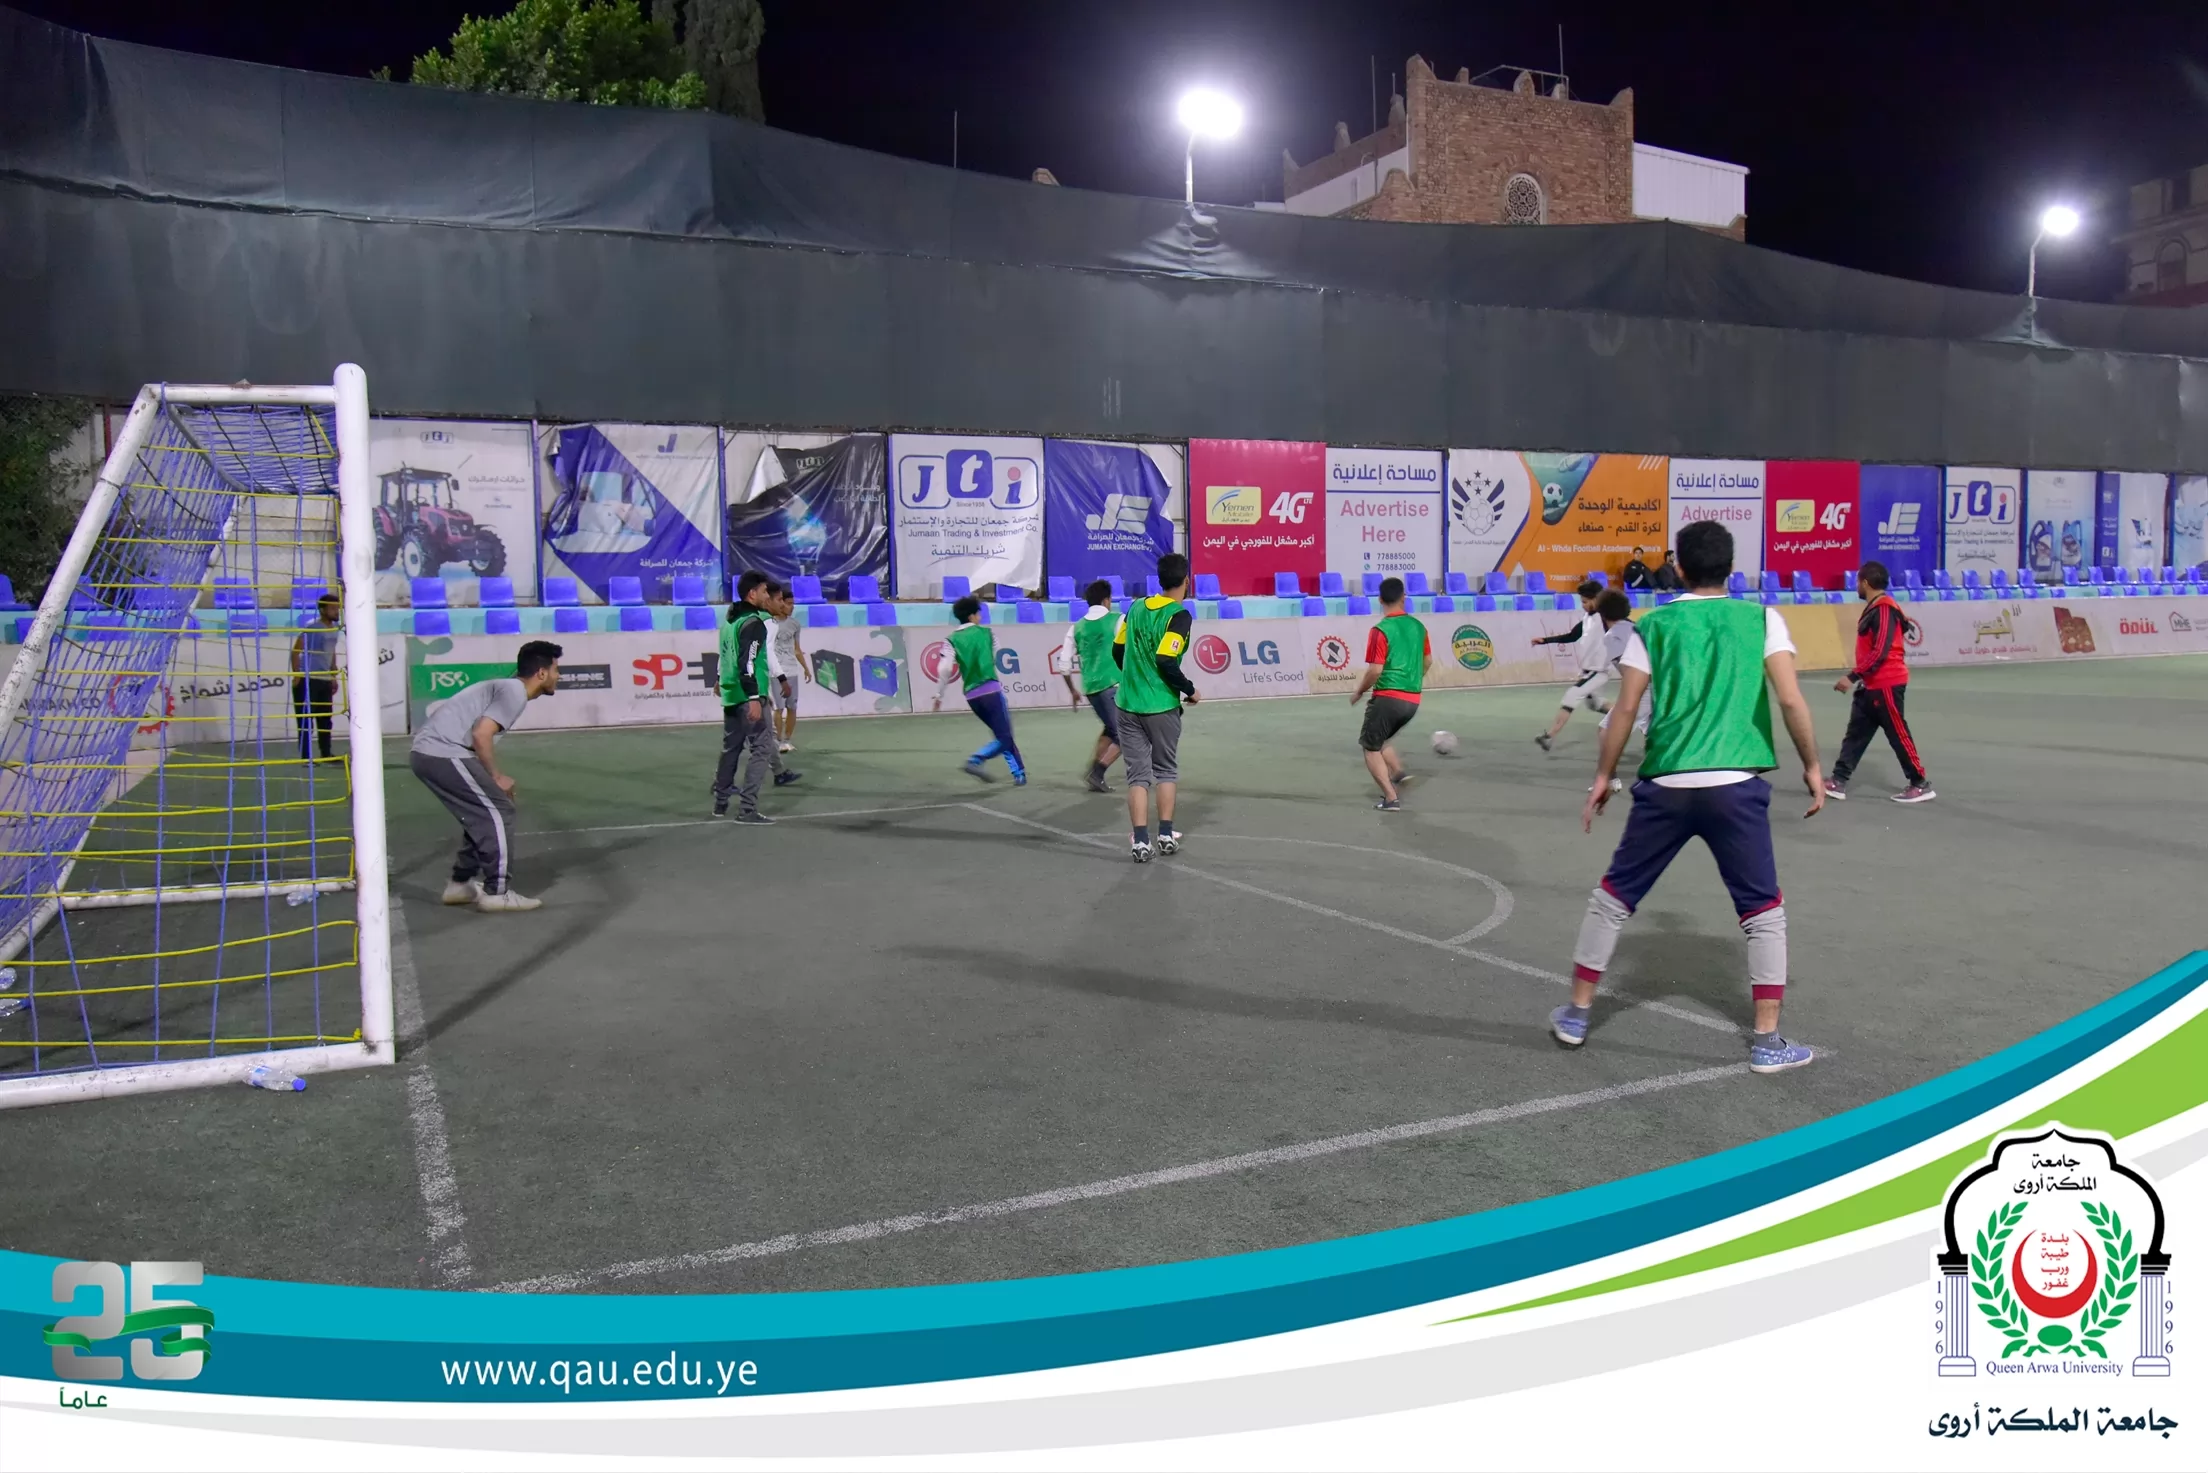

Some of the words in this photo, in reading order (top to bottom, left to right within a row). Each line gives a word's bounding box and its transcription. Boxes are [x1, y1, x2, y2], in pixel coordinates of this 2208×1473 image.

[1333, 463, 1382, 485] إعلانية
[1386, 464, 1437, 482] مساحة
[1718, 473, 1759, 488] مساحة
[1676, 472, 1716, 492] إعلانية
[1221, 502, 1255, 512] Yemen
[1268, 491, 1314, 524] 4G
[1340, 499, 1429, 517] Advertise
[1578, 497, 1614, 514] الوحدة
[1680, 505, 1753, 521] Advertise
[946, 515, 978, 528] للتجارة
[980, 516, 1010, 528] جمعان
[1819, 502, 1852, 531] 4G
[908, 528, 940, 538] Jumaan
[942, 528, 972, 539] Trading
[973, 529, 980, 537] &
[982, 527, 1025, 537] Investment
[1025, 524, 1038, 533] Co.
[1361, 525, 1406, 542] Here
[1578, 521, 1604, 532] صنعاء
[1615, 521, 1639, 537] القدم
[1203, 535, 1226, 548] اليمن
[1227, 535, 1239, 551] في
[1240, 535, 1272, 551] للفورجي
[1273, 535, 1298, 548] مشغل
[1299, 534, 1315, 548] أكبر
[1773, 540, 1790, 551] اليمن
[1790, 540, 1800, 554] في
[931, 543, 970, 560] التنمية
[1376, 552, 1416, 560] 778885000
[1573, 544, 1601, 553] Football
[1602, 544, 1633, 554] Academy
[639, 557, 668, 569] للصرافة
[668, 557, 693, 569] جمعان
[1376, 563, 1416, 571] 778883000
[1237, 640, 1281, 666] LG
[1243, 671, 1272, 684] Life's
[1274, 670, 1304, 682] Good
[237, 677, 285, 693] محمد
[1012, 680, 1047, 693] Good
